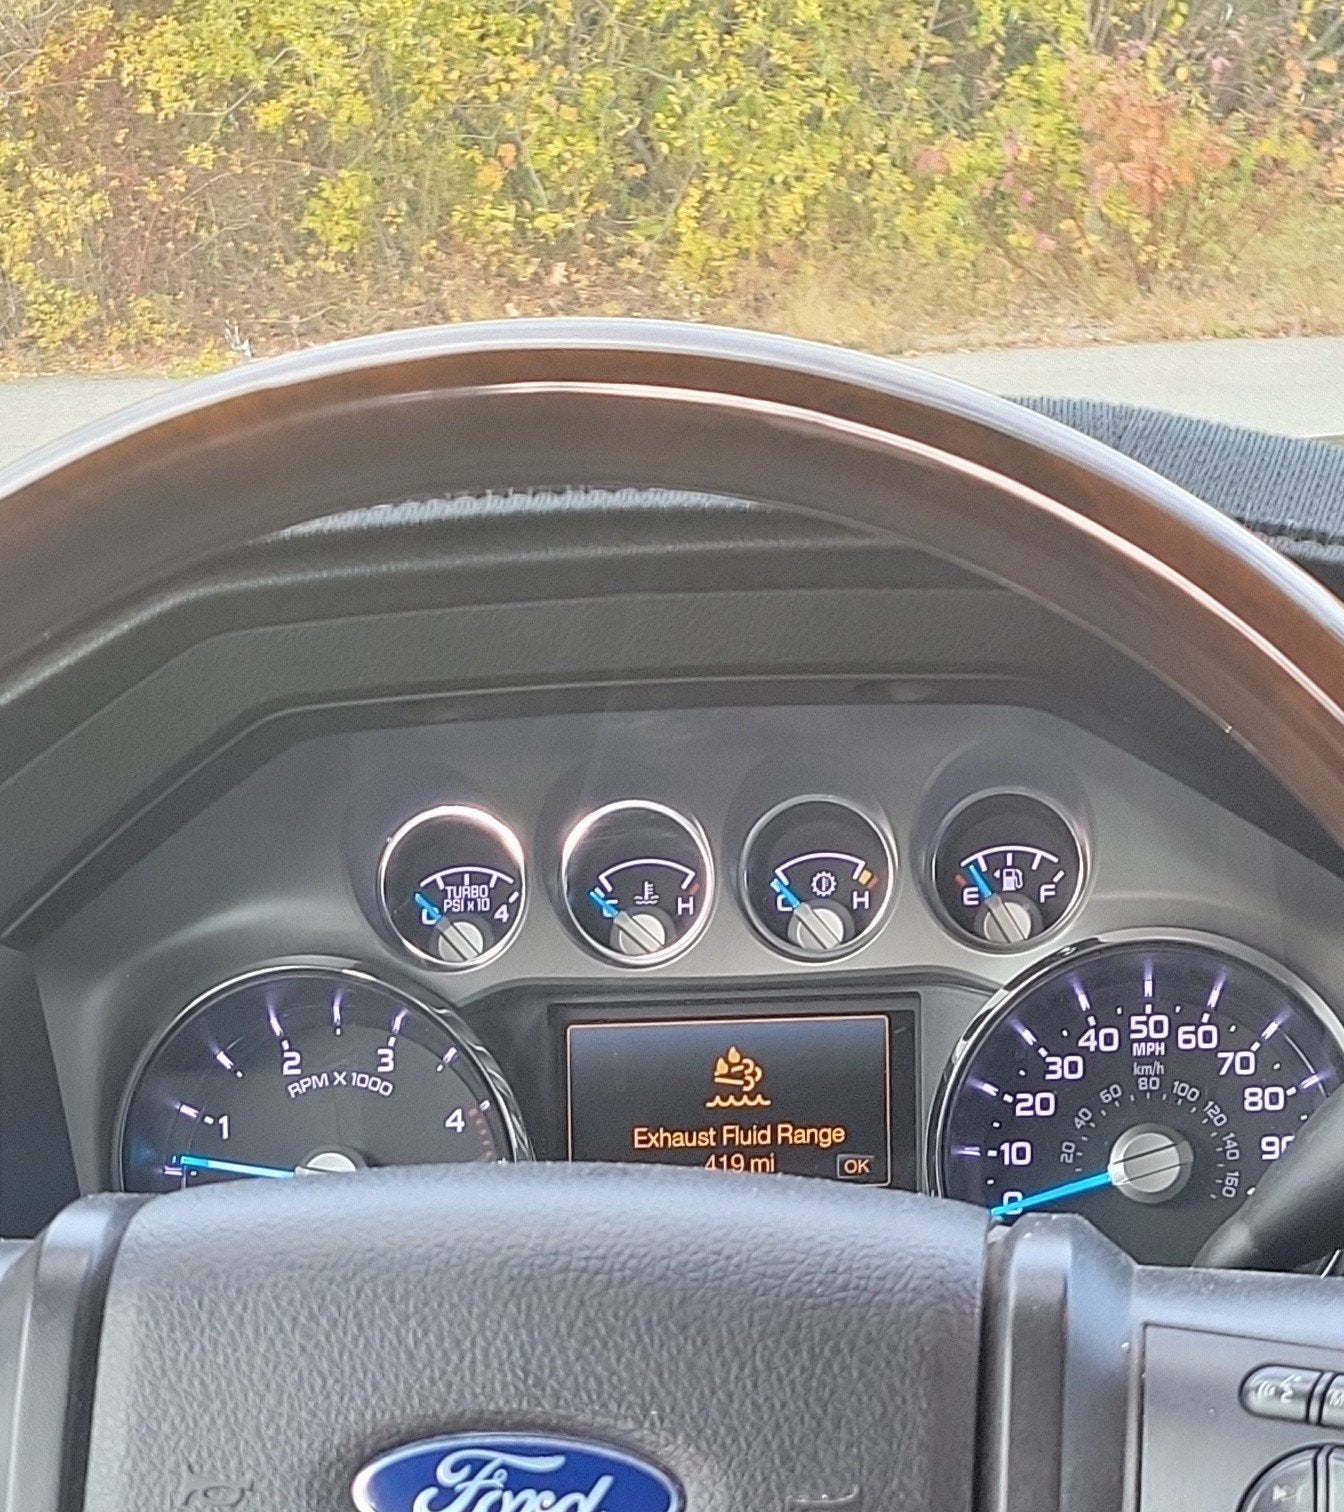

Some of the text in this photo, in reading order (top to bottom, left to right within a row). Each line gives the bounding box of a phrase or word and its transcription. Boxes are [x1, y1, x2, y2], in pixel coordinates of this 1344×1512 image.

[445, 884, 489, 899] TURBO
[852, 891, 870, 910] H
[962, 886, 979, 906] E
[1039, 884, 1056, 903] F
[443, 899, 465, 913] PSI
[493, 904, 510, 923] 4
[677, 896, 694, 916] H
[1078, 1027, 1120, 1053] 40
[1129, 1014, 1169, 1041] 50
[1177, 1024, 1219, 1051] 60
[376, 1048, 395, 1073] 3
[1132, 1042, 1166, 1057] MPH
[282, 1050, 302, 1075] 2
[1044, 1055, 1084, 1081] 30
[1133, 1061, 1165, 1076] km/h
[1217, 1051, 1256, 1077] 70
[287, 1071, 394, 1099] RPM X 1000
[1137, 1076, 1160, 1091] 80
[1171, 1079, 1201, 1103] 100
[1014, 1092, 1056, 1117] 20
[1243, 1086, 1285, 1112] 80
[445, 1108, 466, 1133] 4
[1073, 1107, 1094, 1130] 40
[1201, 1101, 1227, 1128] 120
[218, 1115, 230, 1140] 1
[633, 1123, 846, 1150] Exhaust Fluid Range
[750, 1152, 775, 1173] mi
[999, 1140, 1033, 1166] 10
[843, 1159, 871, 1175] OK
